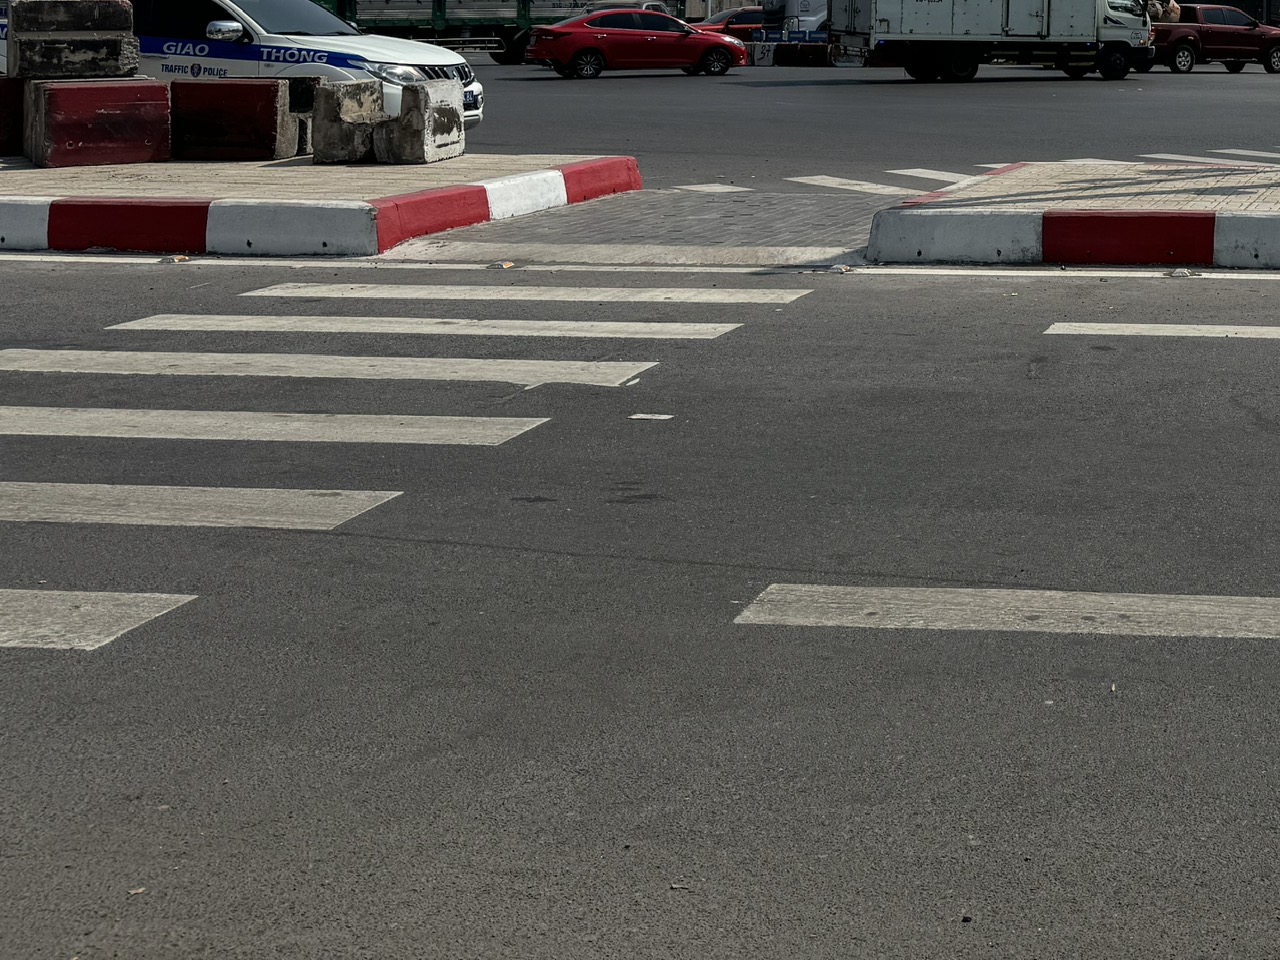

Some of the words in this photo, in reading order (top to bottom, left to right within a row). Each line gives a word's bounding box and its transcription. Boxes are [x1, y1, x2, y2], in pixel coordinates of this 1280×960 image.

[162, 42, 210, 56] GIAO
[260, 47, 329, 63] THÔNG
[161, 63, 189, 74] TRAFFIC
[202, 68, 228, 77] POLICE
